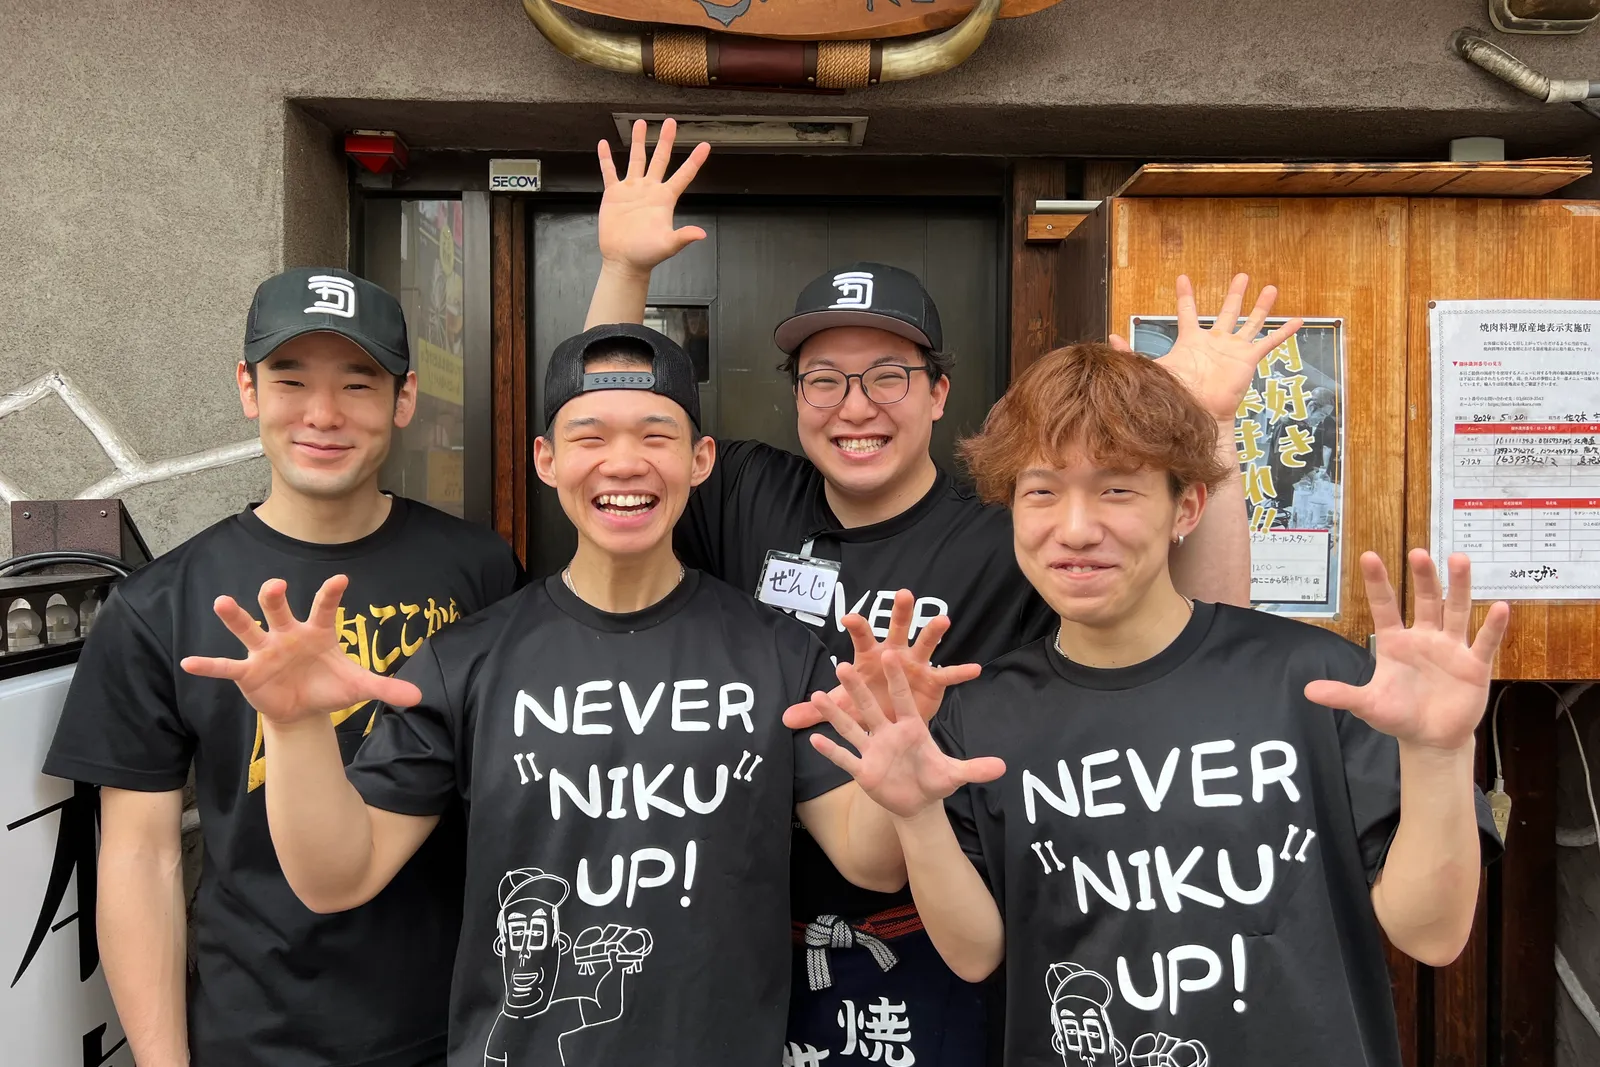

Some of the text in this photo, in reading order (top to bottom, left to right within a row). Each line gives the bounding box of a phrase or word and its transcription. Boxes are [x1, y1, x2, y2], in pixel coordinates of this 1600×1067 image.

[492, 175, 538, 188] SECOM
[1479, 322, 1592, 333] 焼肉料理原産地表示実施店
[1251, 534, 1314, 543] チン・ホールスタッフ
[769, 568, 827, 601] ぜんじ
[252, 597, 461, 675] 肉ここから
[513, 679, 755, 737] NEVER
[1021, 739, 1301, 825] NEVER
[576, 840, 697, 909] UP!
[1116, 933, 1246, 1016] UP!
[837, 996, 916, 1067] 焼
